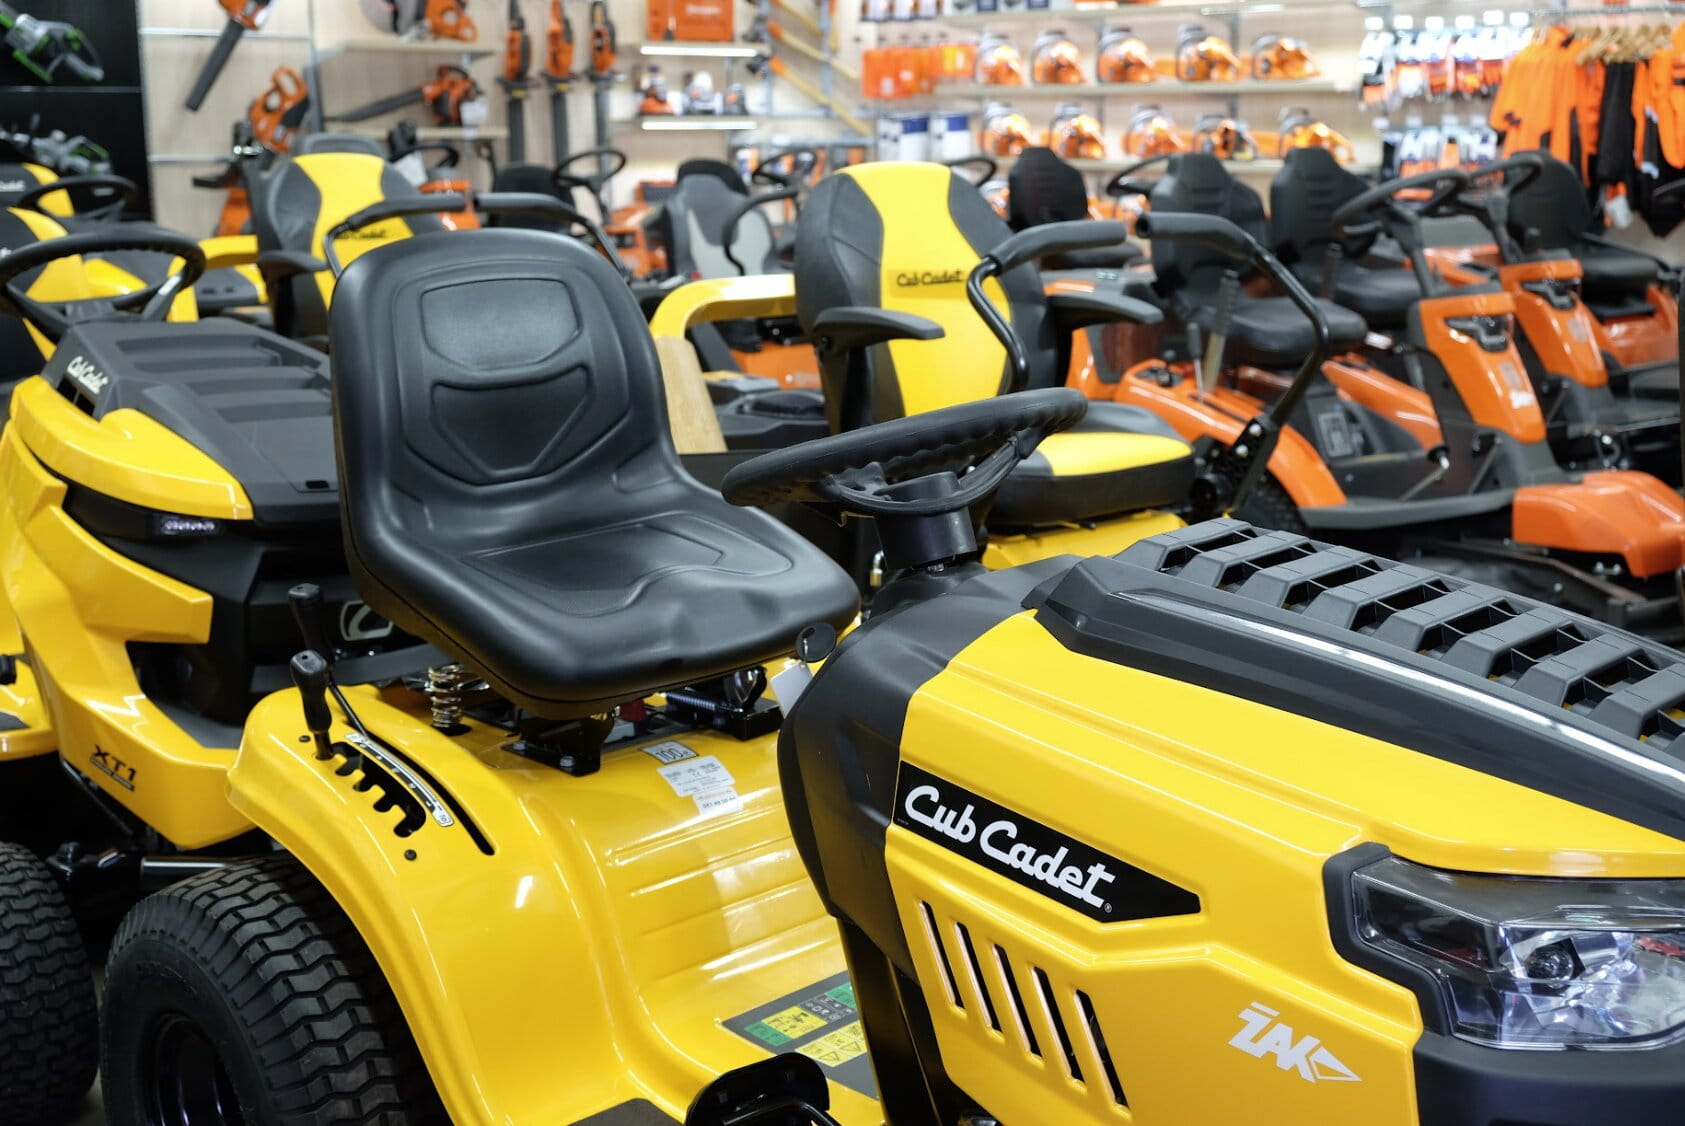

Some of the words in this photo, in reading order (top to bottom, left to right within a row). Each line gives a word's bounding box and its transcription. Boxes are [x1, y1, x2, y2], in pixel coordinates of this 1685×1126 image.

[896, 271, 919, 288] Cub
[920, 269, 964, 286] Cadet
[78, 364, 109, 395] Cadet
[92, 744, 137, 782] XT1
[904, 785, 977, 844] Cub
[979, 820, 1116, 908] Cadet
